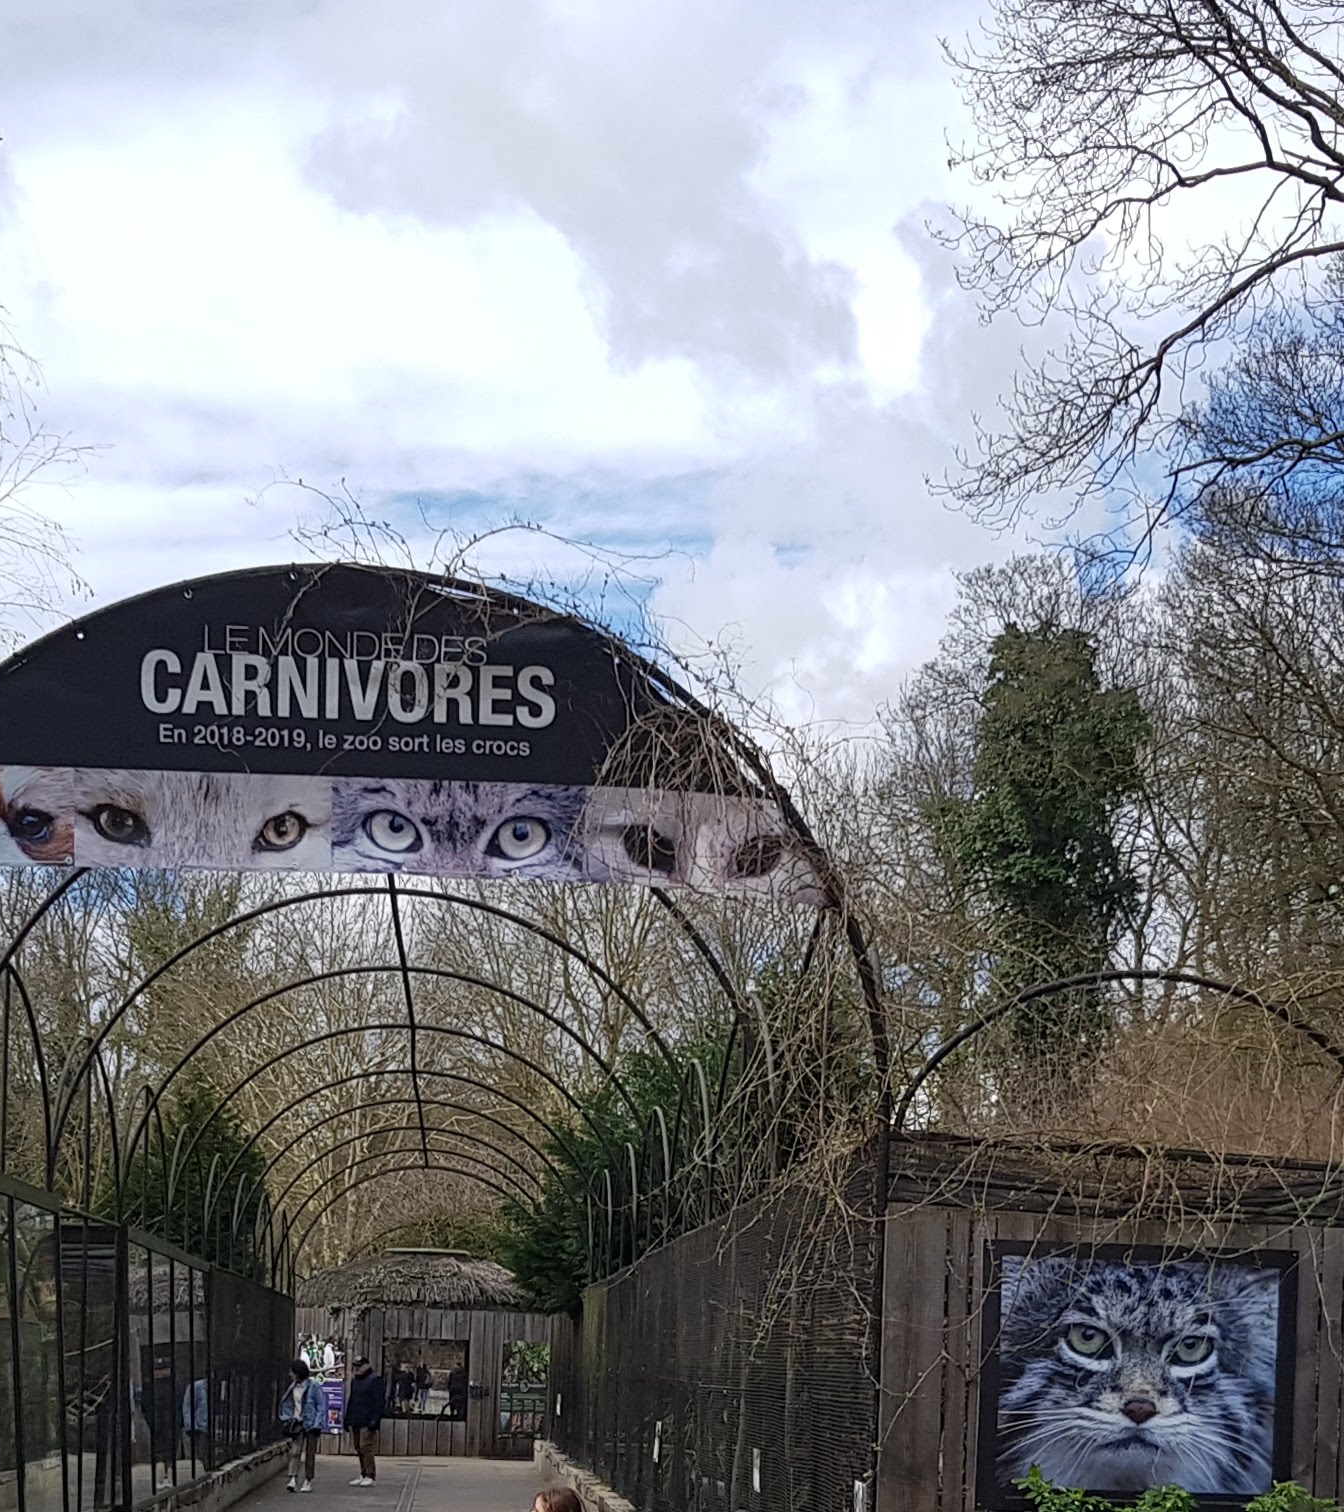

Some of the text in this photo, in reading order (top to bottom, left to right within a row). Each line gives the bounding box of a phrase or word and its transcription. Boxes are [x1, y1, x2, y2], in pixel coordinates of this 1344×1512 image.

[203, 623, 488, 667] LE MONDE DES
[140, 648, 557, 730] CARNIVORES
[158, 723, 531, 757] En 2018-2019, le zoo sort les crocs
